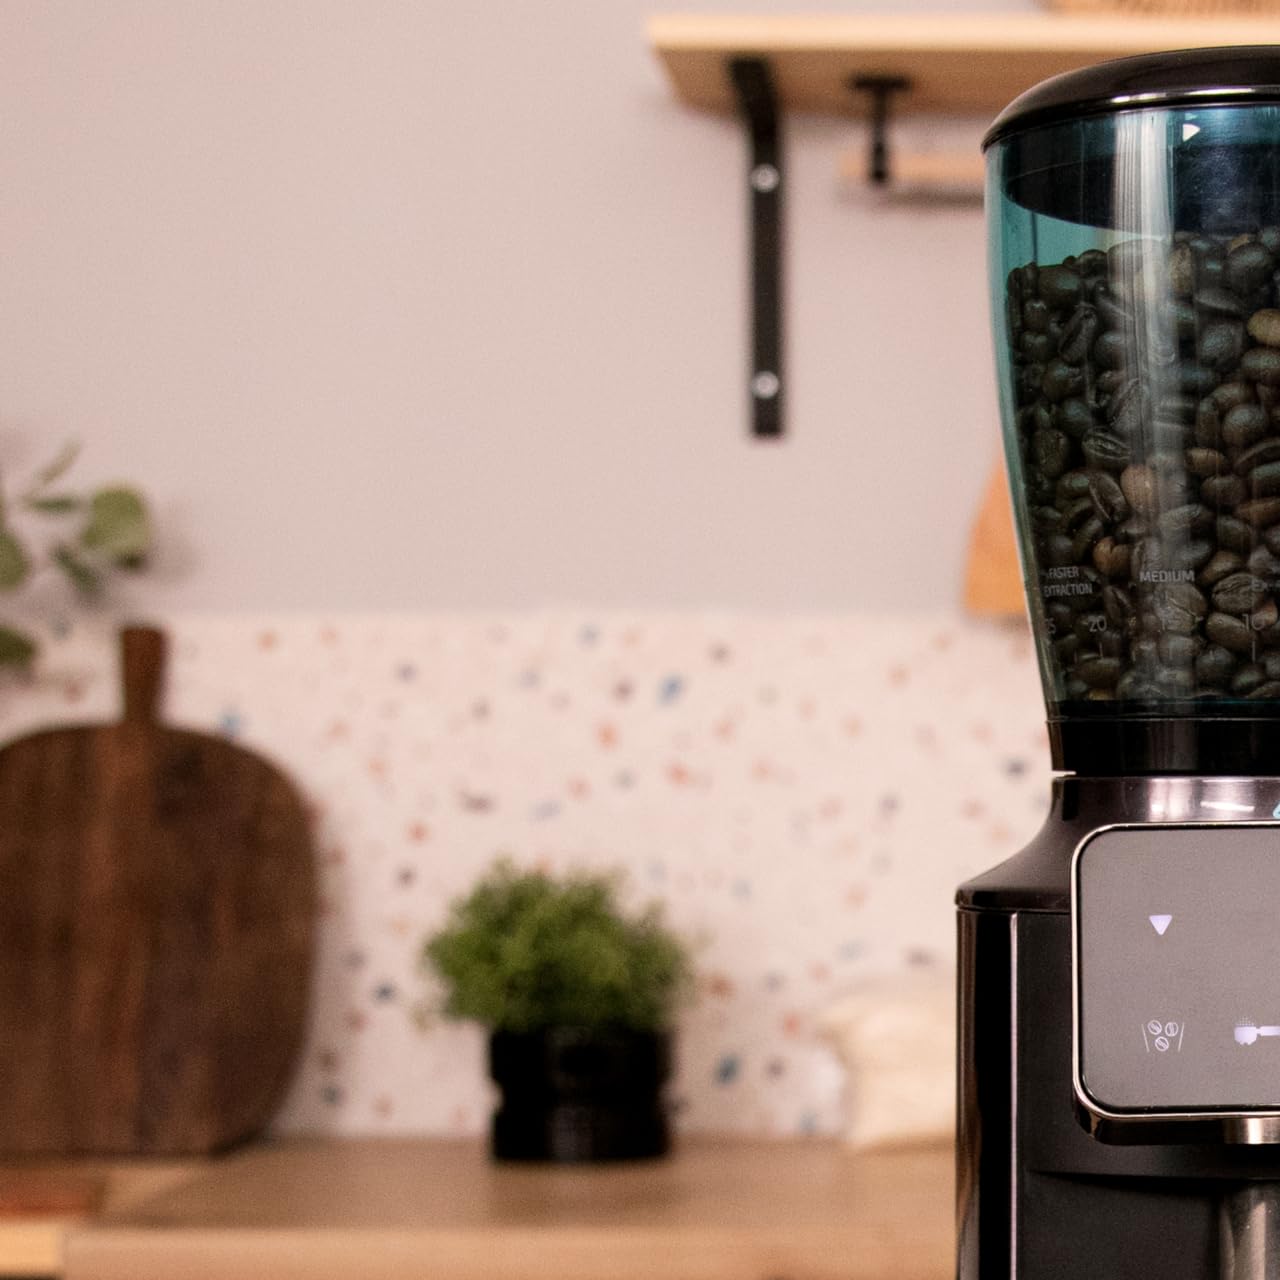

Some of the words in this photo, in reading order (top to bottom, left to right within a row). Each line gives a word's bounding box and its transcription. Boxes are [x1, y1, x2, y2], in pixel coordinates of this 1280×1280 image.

[1139, 570, 1195, 582] MEDIUM
[1087, 615, 1107, 632] 20
[1242, 613, 1265, 631] 10
